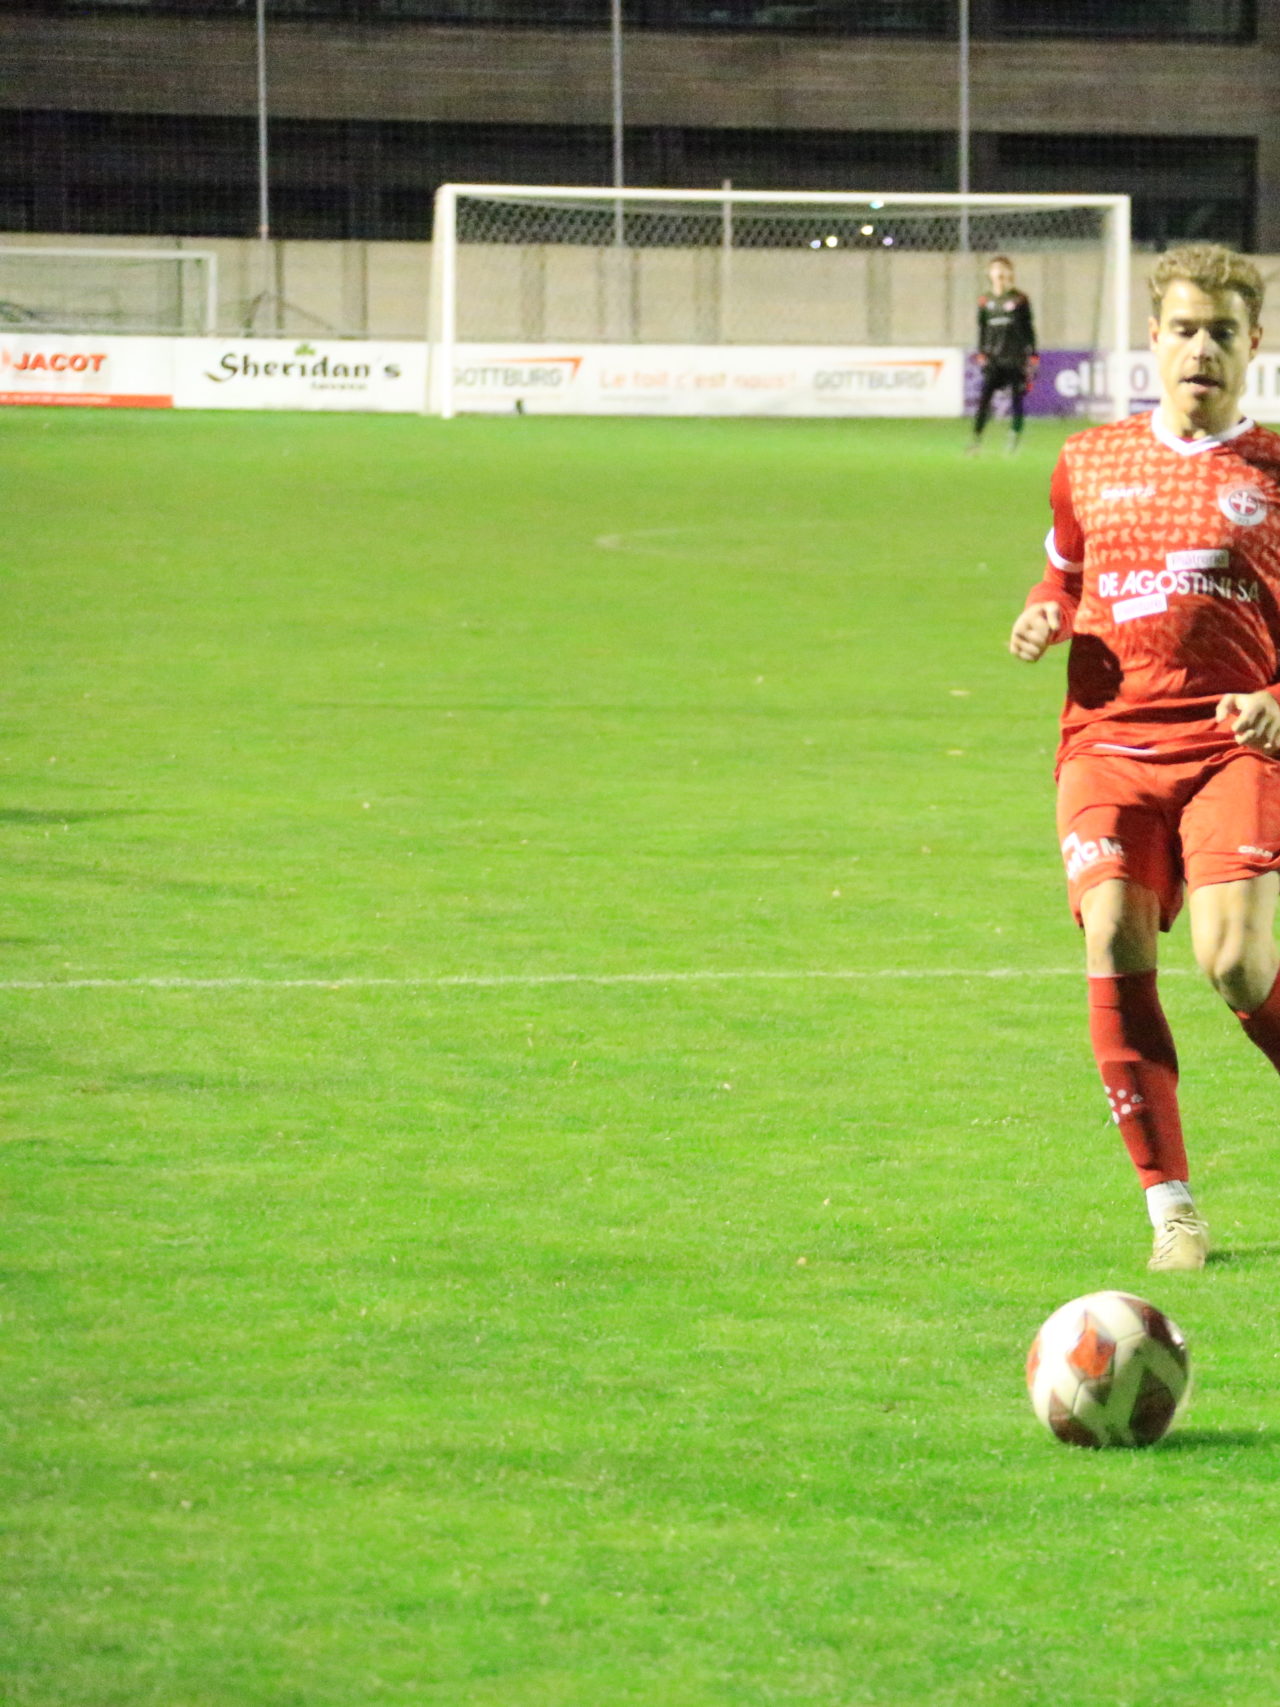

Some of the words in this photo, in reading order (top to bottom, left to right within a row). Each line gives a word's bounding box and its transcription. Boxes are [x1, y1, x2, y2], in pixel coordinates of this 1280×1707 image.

[14, 353, 107, 371] JACOT
[1099, 573, 1118, 598] DE
[1120, 570, 1231, 600] AGOSTINI
